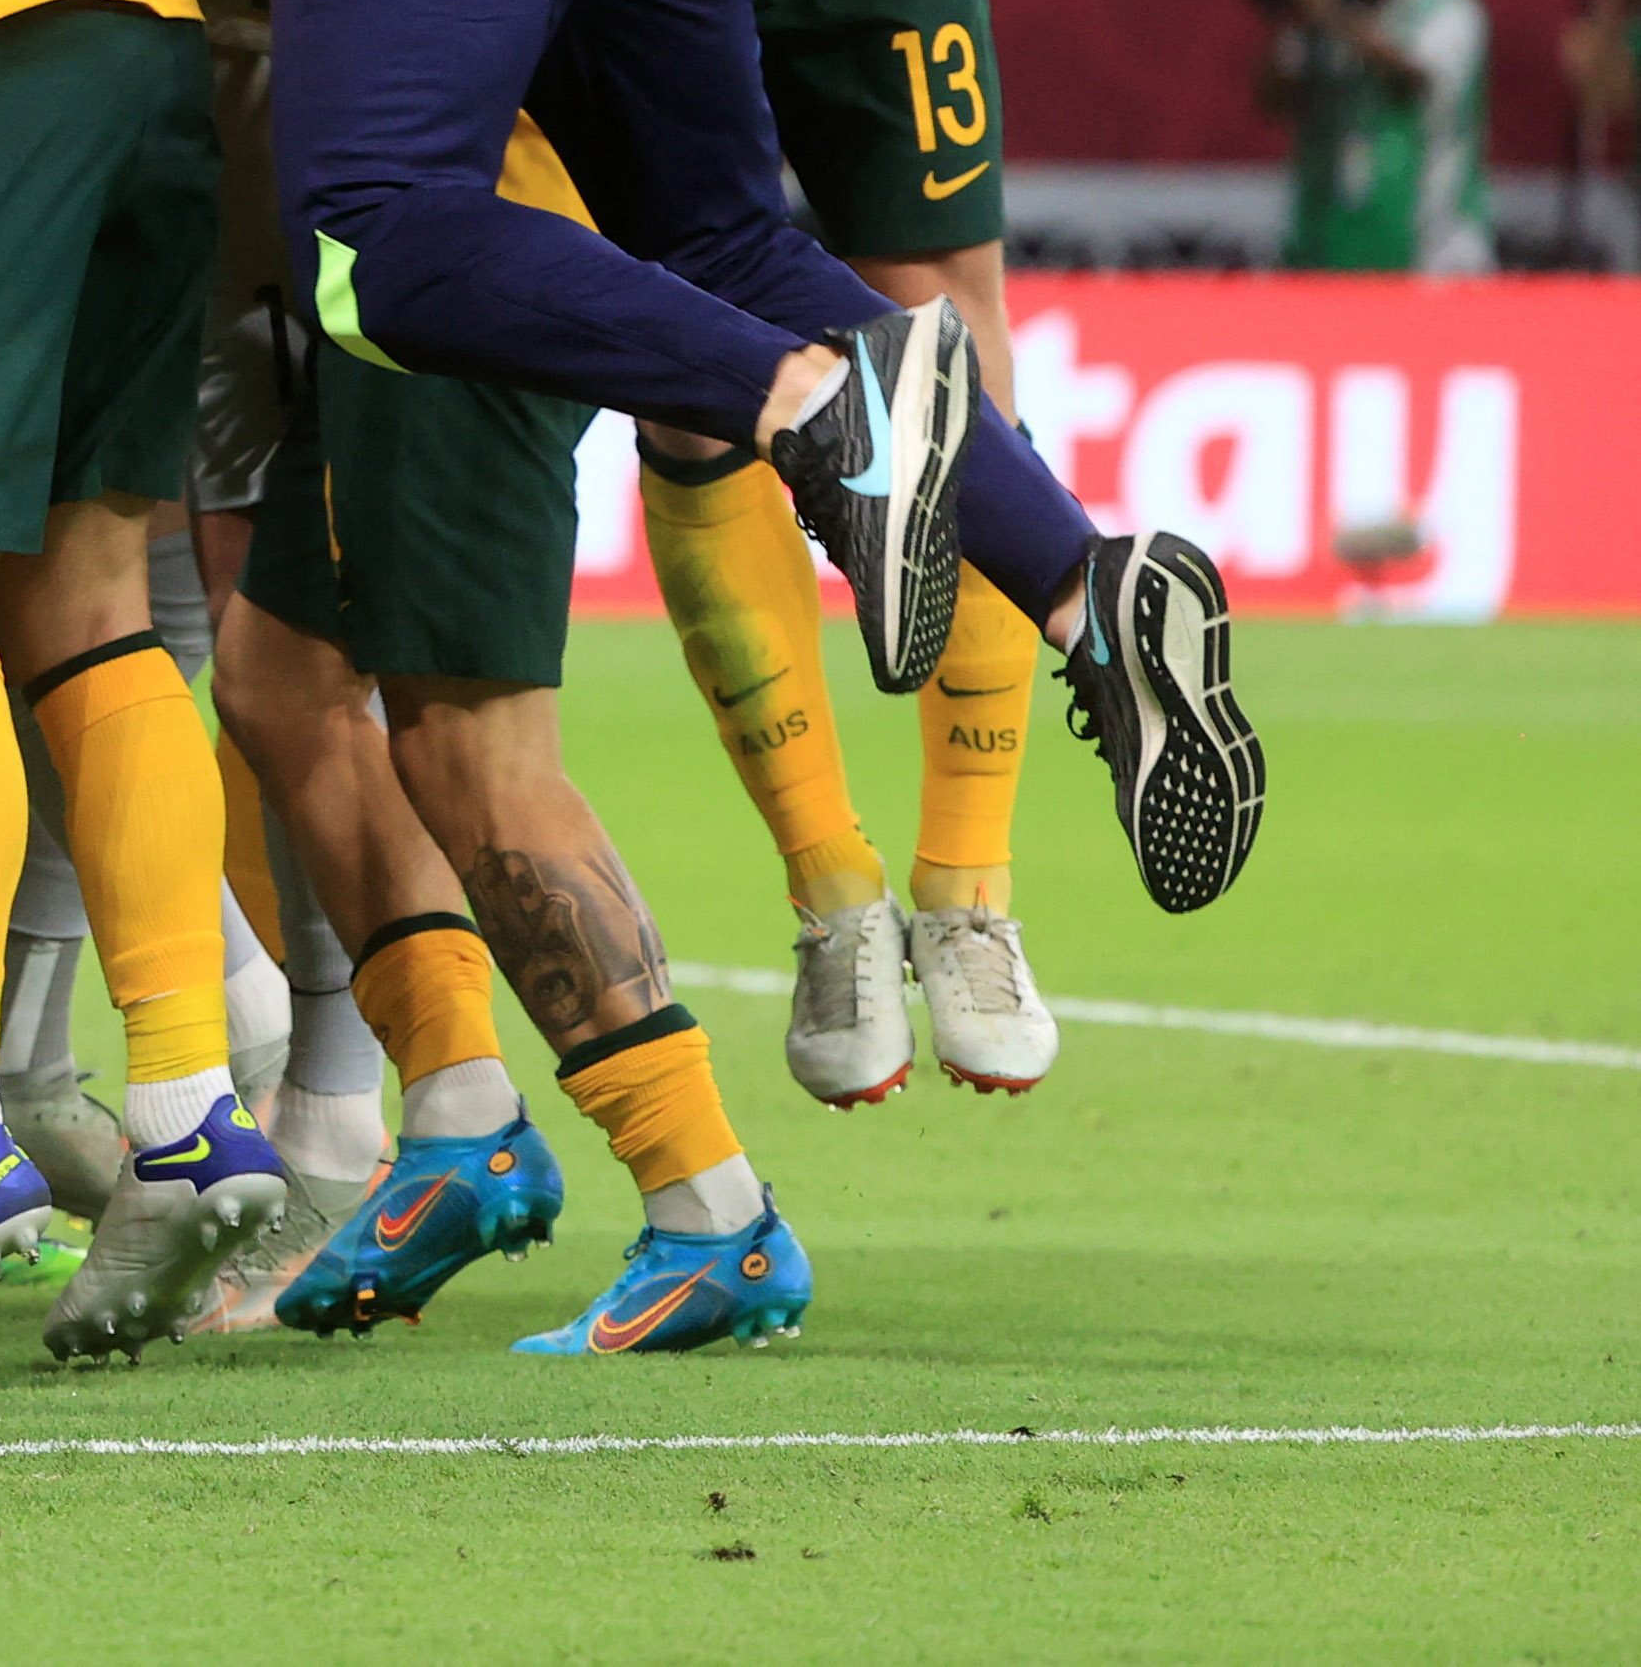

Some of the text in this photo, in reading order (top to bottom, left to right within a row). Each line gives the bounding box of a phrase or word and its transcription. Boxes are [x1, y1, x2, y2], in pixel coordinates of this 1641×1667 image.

[890, 22, 987, 153] 13
[741, 710, 809, 756] AUS
[948, 724, 1017, 753] AUS
